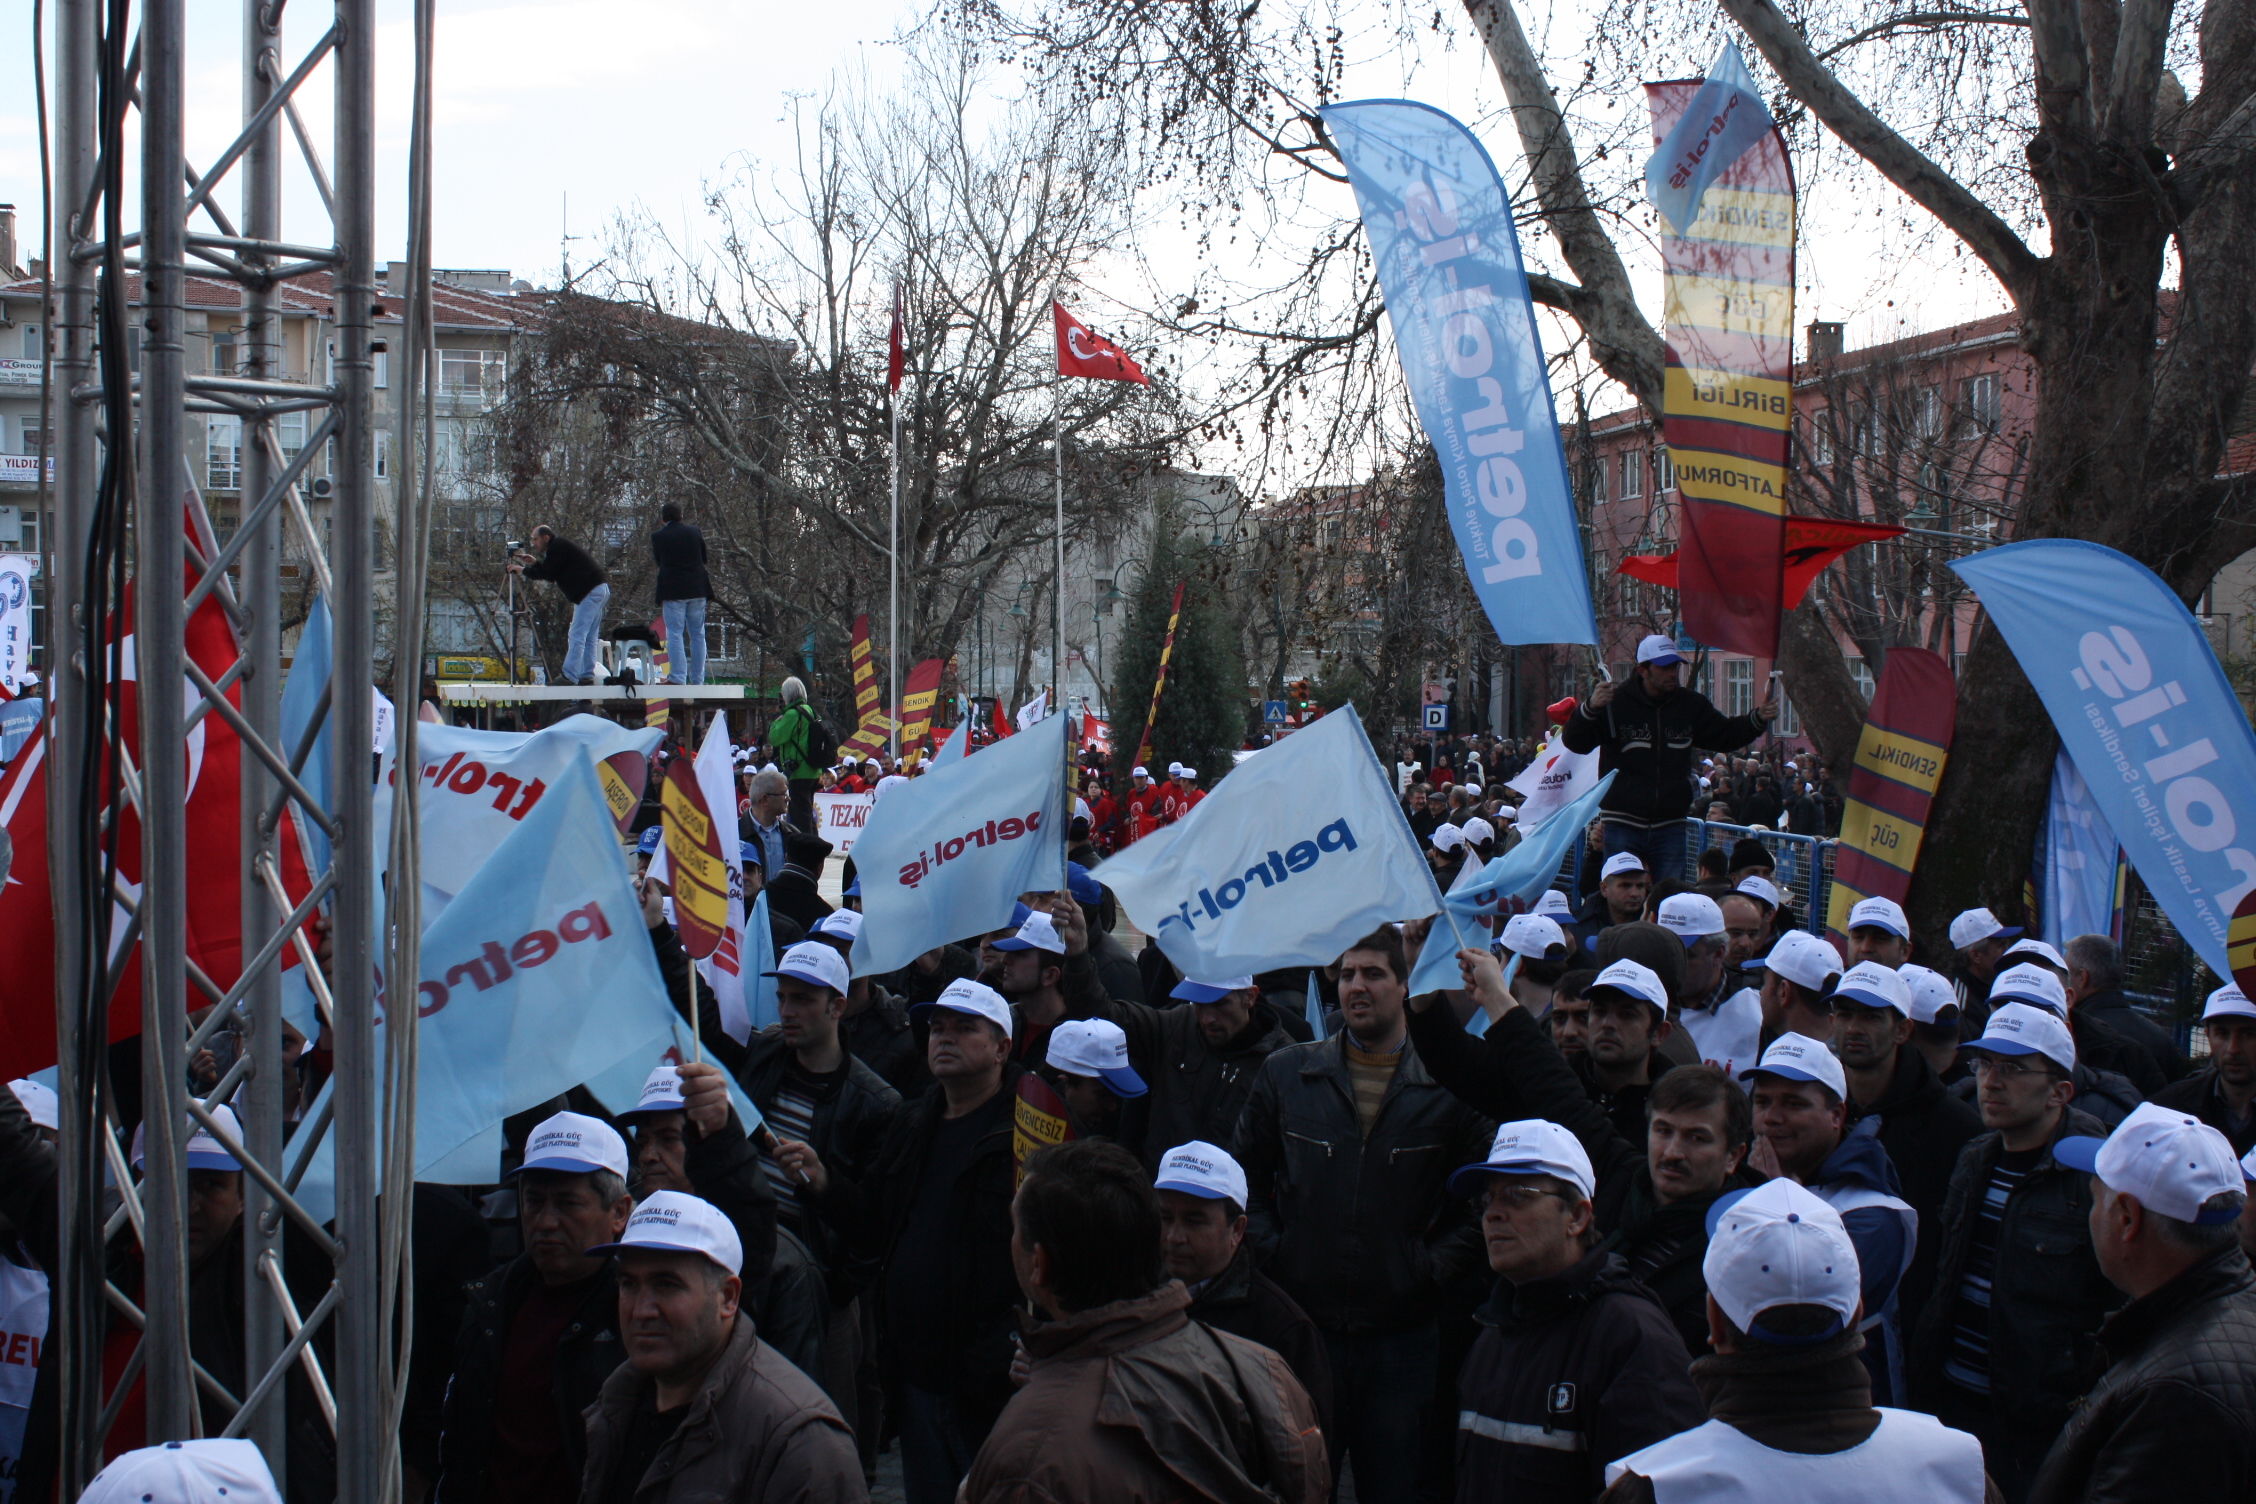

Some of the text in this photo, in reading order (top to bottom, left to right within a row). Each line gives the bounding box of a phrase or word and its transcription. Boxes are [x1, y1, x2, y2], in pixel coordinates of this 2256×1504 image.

[5, 458, 39, 469] YILDIZ
[5, 625, 18, 687] Hava
[1429, 710, 1442, 725] D
[605, 778, 632, 815] TAŞERON
[1016, 1101, 1063, 1141] GÜVENCESİZ
[566, 1132, 582, 1141] GÜÇ
[1200, 1159, 1214, 1170] GÜÇ
[664, 1208, 681, 1218] GÜÇ
